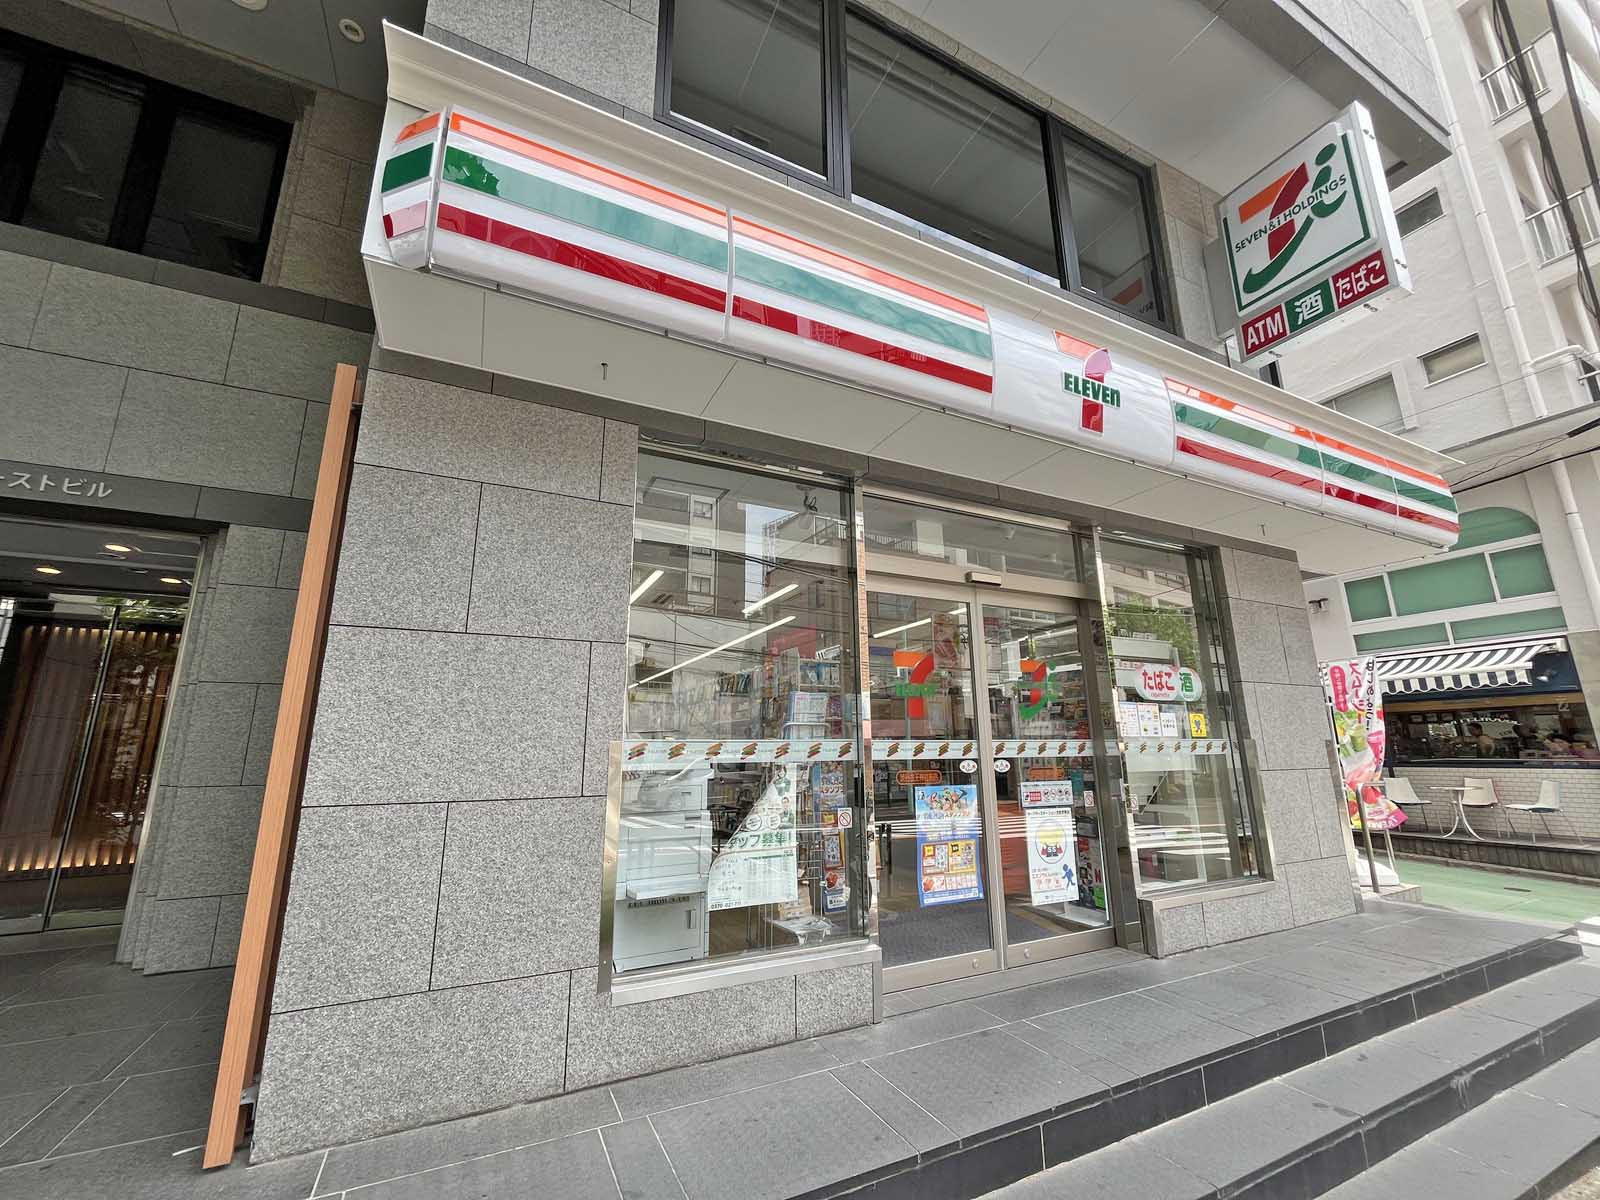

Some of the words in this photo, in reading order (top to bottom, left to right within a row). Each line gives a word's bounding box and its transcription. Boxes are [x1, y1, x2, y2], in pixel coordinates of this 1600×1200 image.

[1283, 174, 1347, 220] HOLDINGS
[1335, 260, 1385, 303] たばこ
[1294, 290, 1324, 325] 酒
[1246, 314, 1284, 350] ATM
[1142, 669, 1175, 692] たばこ
